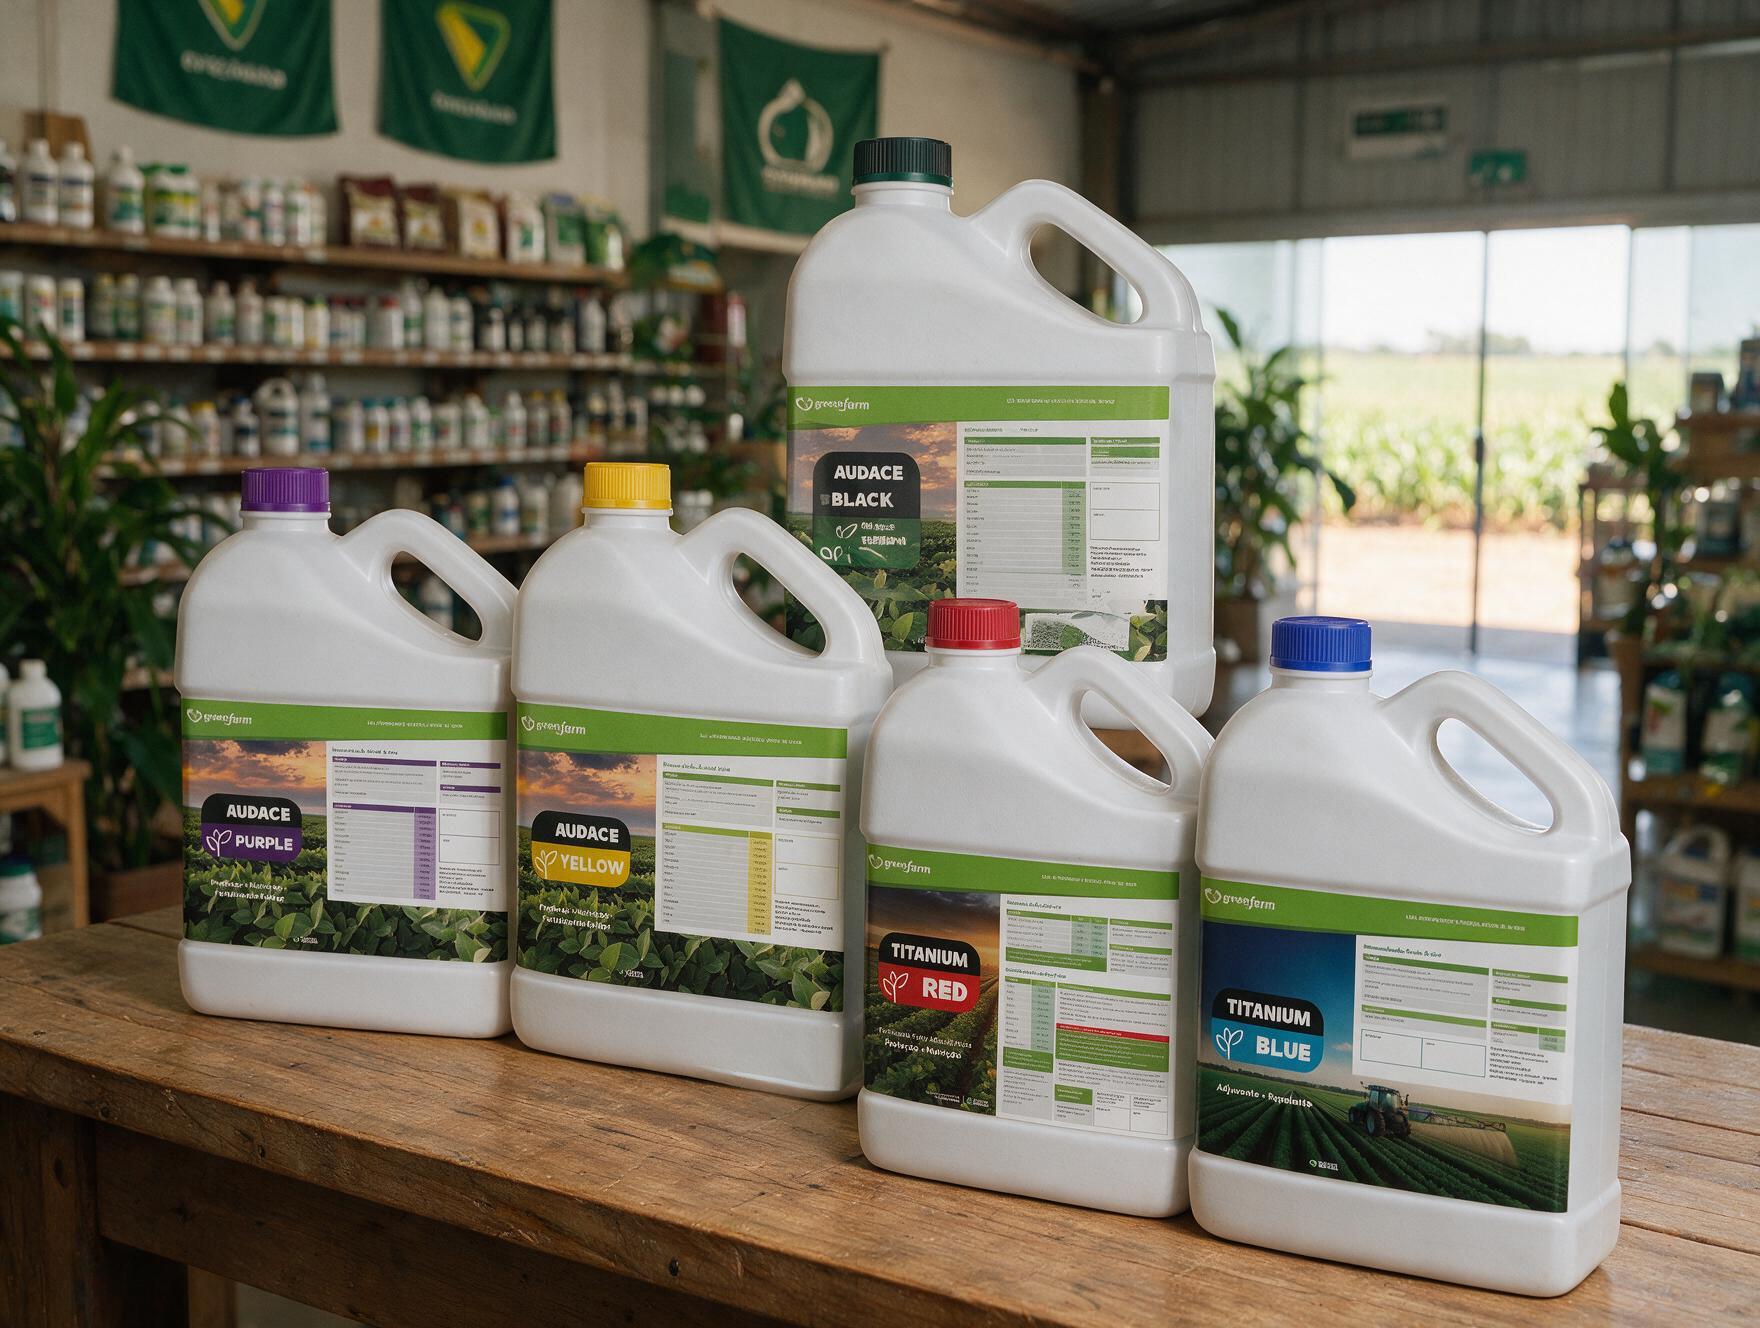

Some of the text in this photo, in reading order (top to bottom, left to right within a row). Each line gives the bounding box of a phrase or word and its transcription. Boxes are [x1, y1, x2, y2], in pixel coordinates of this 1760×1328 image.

[833, 464, 904, 482] AUDACE
[831, 491, 894, 508] BLACK
[226, 803, 291, 822] AUDACE
[235, 834, 294, 852] PURPLE
[555, 822, 619, 844] AUDACE
[560, 853, 625, 876] YELLOW
[891, 942, 968, 968] TITANIUM
[922, 977, 968, 1003] RED
[1226, 997, 1311, 1027] TITANIUM
[1256, 1035, 1311, 1062] BLUE
